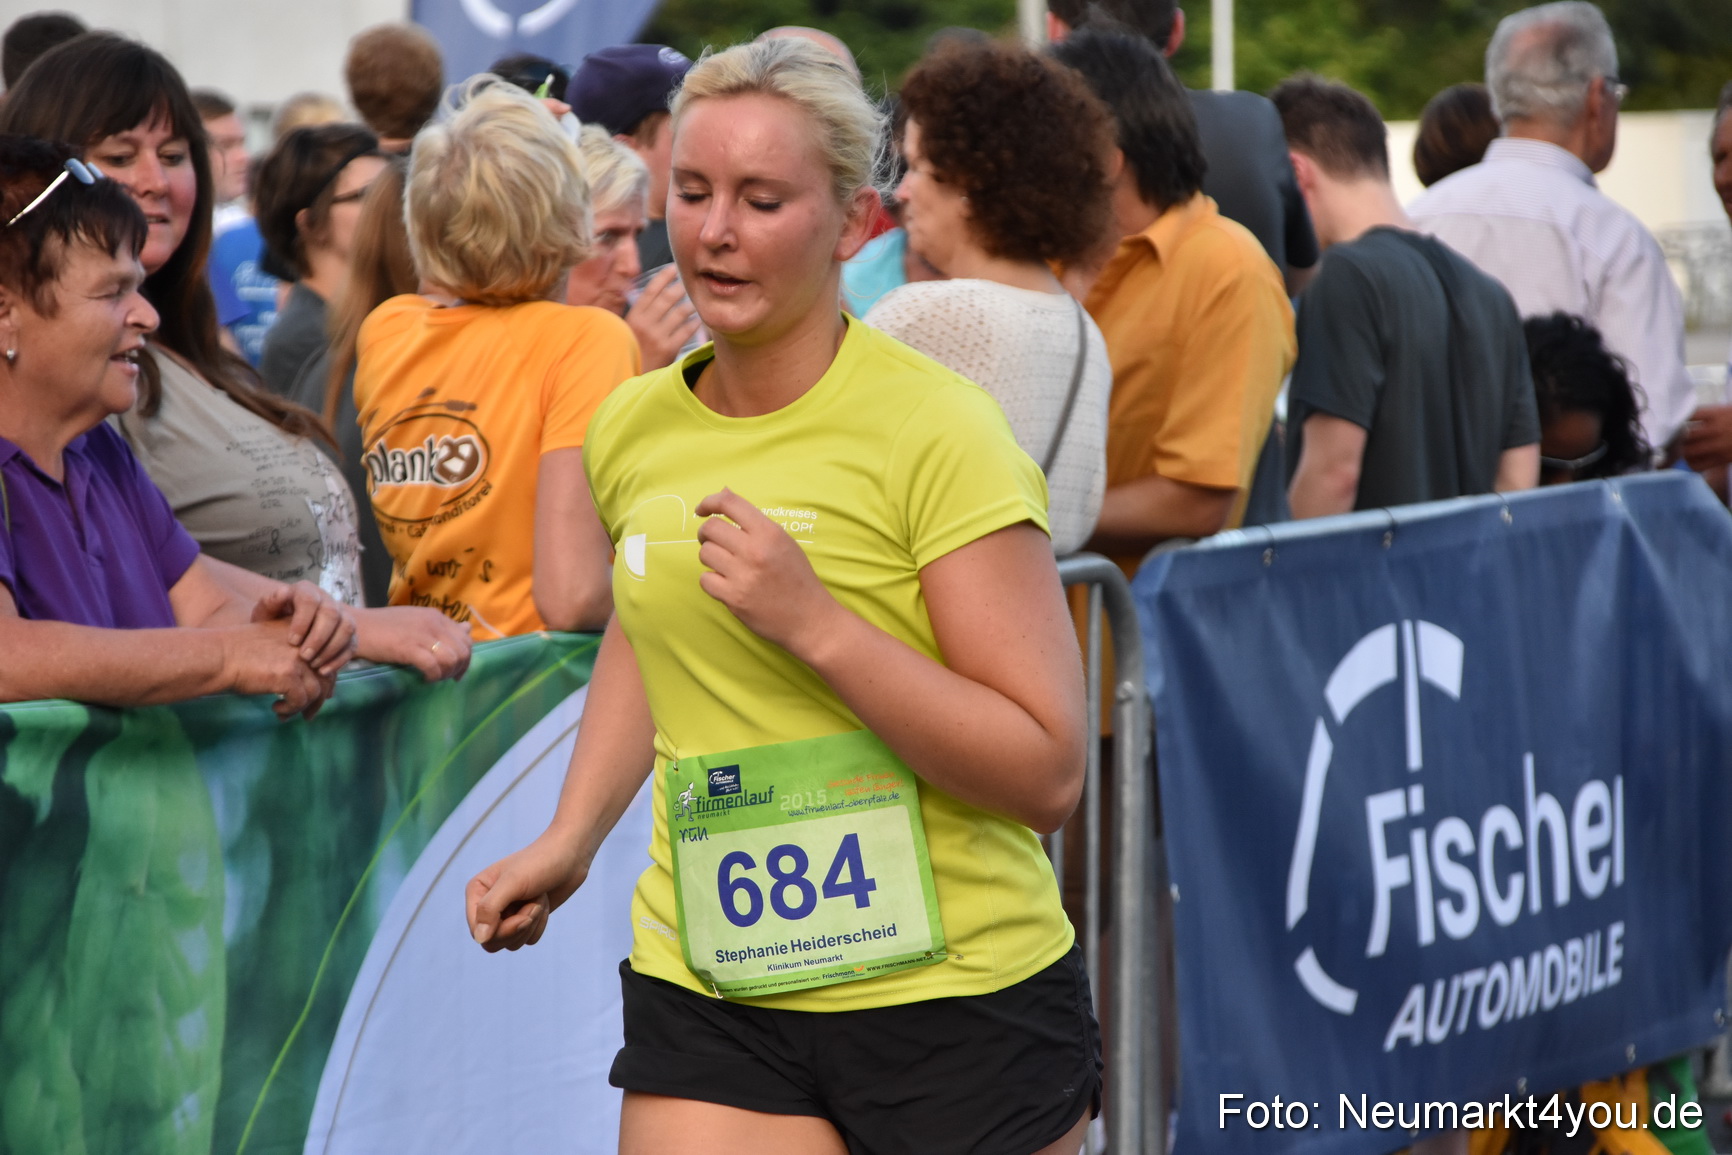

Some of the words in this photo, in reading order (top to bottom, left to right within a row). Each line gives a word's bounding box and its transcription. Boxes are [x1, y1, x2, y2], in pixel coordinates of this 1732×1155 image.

[432, 482, 493, 525] onditorei
[756, 506, 817, 520] andkreises
[713, 774, 736, 783] Fischer
[696, 785, 774, 814] firmenlauf
[780, 789, 827, 811] 2015
[697, 809, 731, 820] neumarkt
[717, 833, 877, 928] 684
[639, 916, 677, 941] SPIRO
[715, 941, 788, 964] Stephanie
[790, 923, 898, 953] Heiderscheid
[767, 960, 802, 972] Klinikum
[803, 953, 844, 969] Neumarkt
[822, 969, 855, 980] Frischmann
[1384, 921, 1625, 1052] AUTOMOBILE
